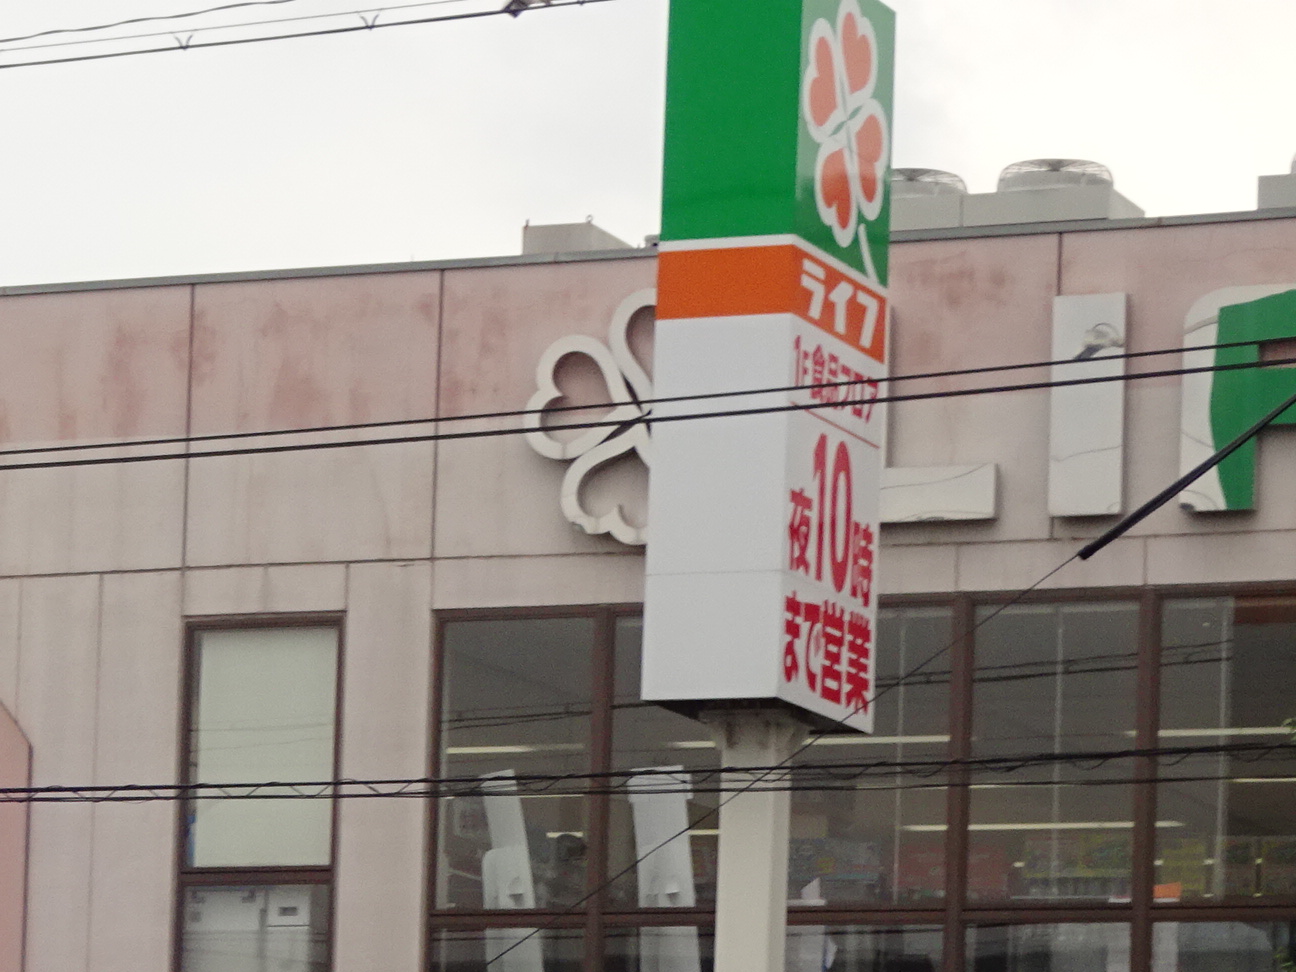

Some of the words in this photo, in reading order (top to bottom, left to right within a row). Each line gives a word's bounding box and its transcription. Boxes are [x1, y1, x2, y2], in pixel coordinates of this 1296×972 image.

[800, 257, 879, 349] ライフ
[788, 432, 874, 608] 夜10時
[783, 590, 872, 716] まで営業
